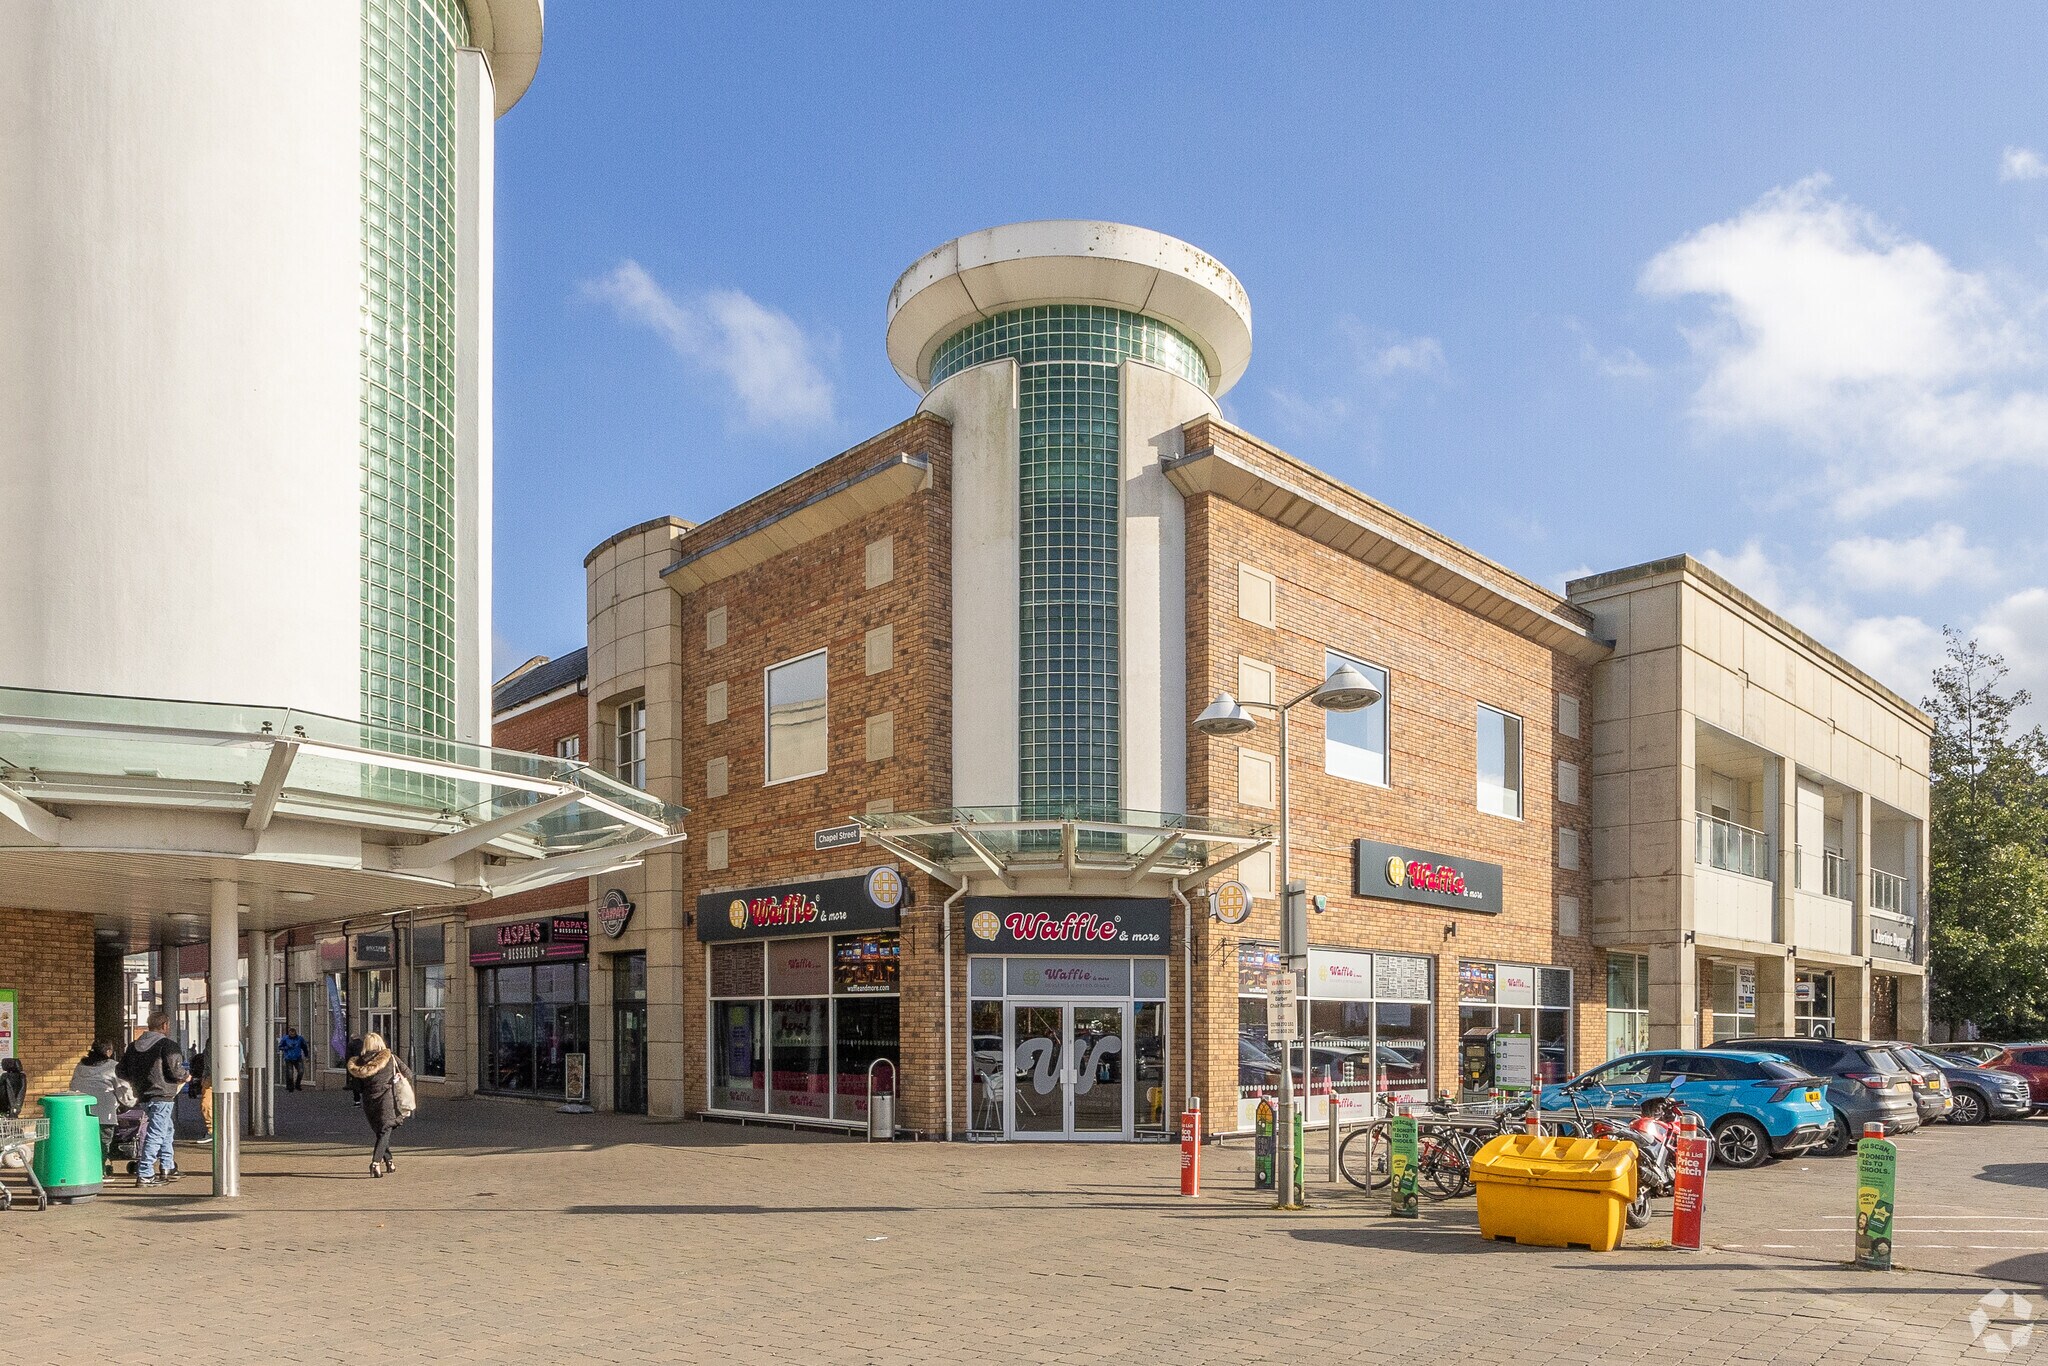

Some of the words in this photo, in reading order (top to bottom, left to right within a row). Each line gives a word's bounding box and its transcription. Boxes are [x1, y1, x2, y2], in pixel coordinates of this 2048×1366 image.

[819, 833, 839, 843] Chapel
[839, 830, 857, 840] Street
[821, 911, 827, 922] &
[829, 912, 847, 921] more
[554, 920, 588, 930] KASPA'S
[497, 922, 540, 945] KASPA'S
[1119, 931, 1129, 942] &
[1132, 932, 1160, 942] more
[508, 946, 539, 960] DESSERTS
[847, 984, 890, 992] waffleandmore.com
[1742, 985, 1748, 994] TO
[1677, 1156, 1699, 1167] Price
